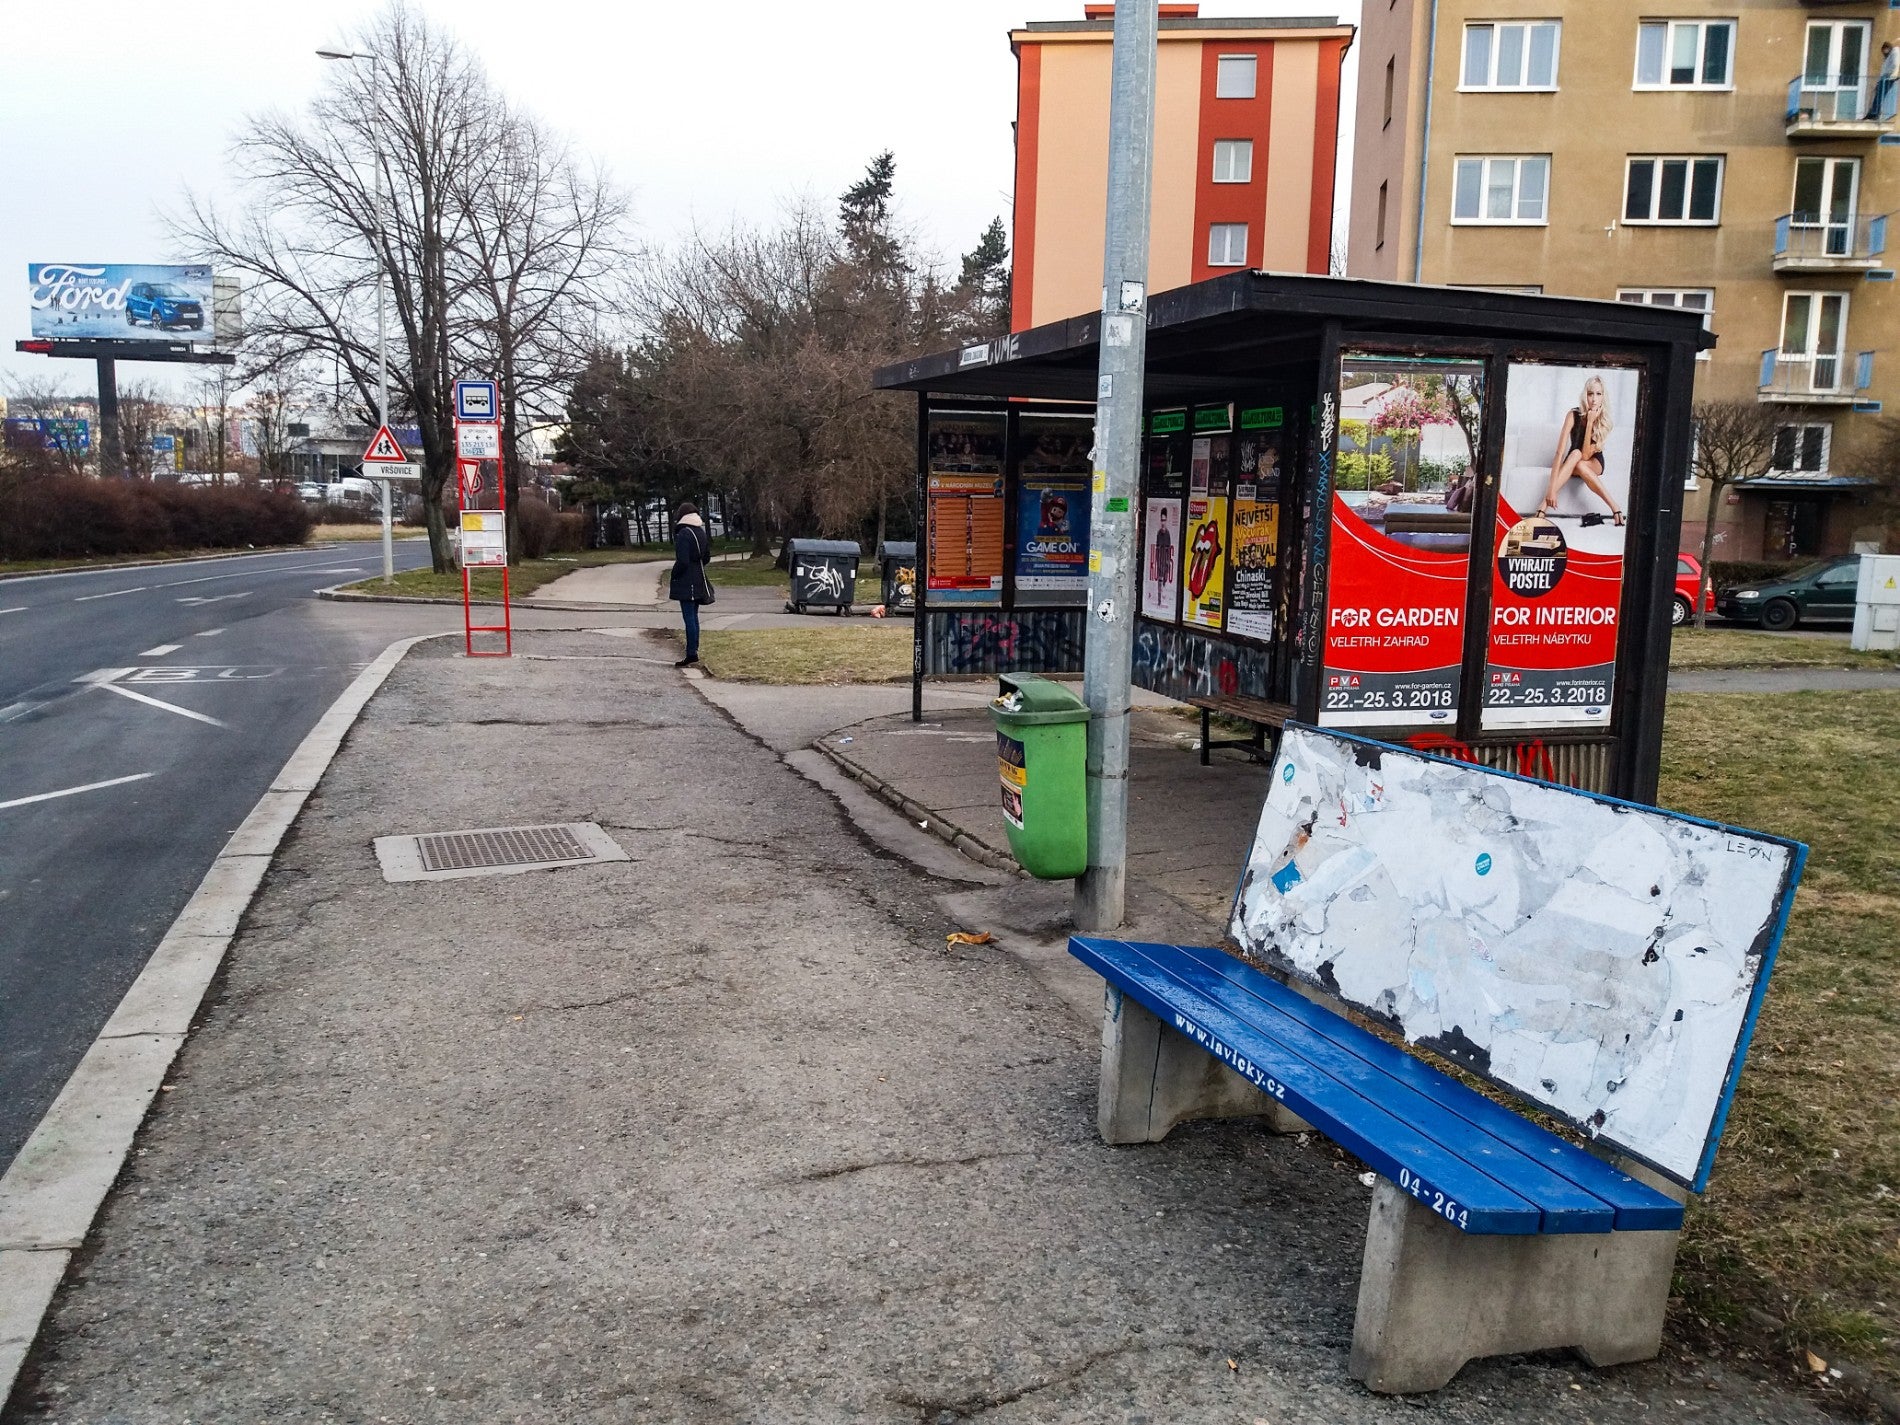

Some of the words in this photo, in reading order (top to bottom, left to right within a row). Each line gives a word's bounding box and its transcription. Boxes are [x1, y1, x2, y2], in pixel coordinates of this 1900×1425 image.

[28, 265, 132, 311] Ford
[380, 465, 412, 475] VRŠOVICE
[1235, 503, 1274, 526] NEJVĚTŠÍ
[1026, 541, 1057, 553] GAME
[1059, 542, 1077, 553] ON
[1508, 558, 1556, 572] VYHRAJTE
[1236, 568, 1266, 583] Chinaski
[1509, 573, 1552, 589] POSTEL
[1331, 607, 1372, 627] FOR
[1376, 607, 1459, 627] GARDEN
[1493, 607, 1531, 626] FOR
[1536, 607, 1617, 625] INTERIOR
[1330, 637, 1381, 648] VELETRH
[1383, 635, 1430, 647] ZAHRAD
[1493, 634, 1540, 645] VELETRH
[1543, 632, 1592, 645] NÁBYTKU
[1330, 677, 1360, 686] PVA
[1491, 673, 1521, 682] PVA
[1395, 682, 1452, 690] www.for-garden.cz
[1392, 691, 1407, 708] 3.
[1410, 690, 1453, 707] 2018
[1551, 688, 1565, 703] 3.
[1567, 687, 1606, 703] 2018
[1174, 1012, 1286, 1100] www.lavicky.cz
